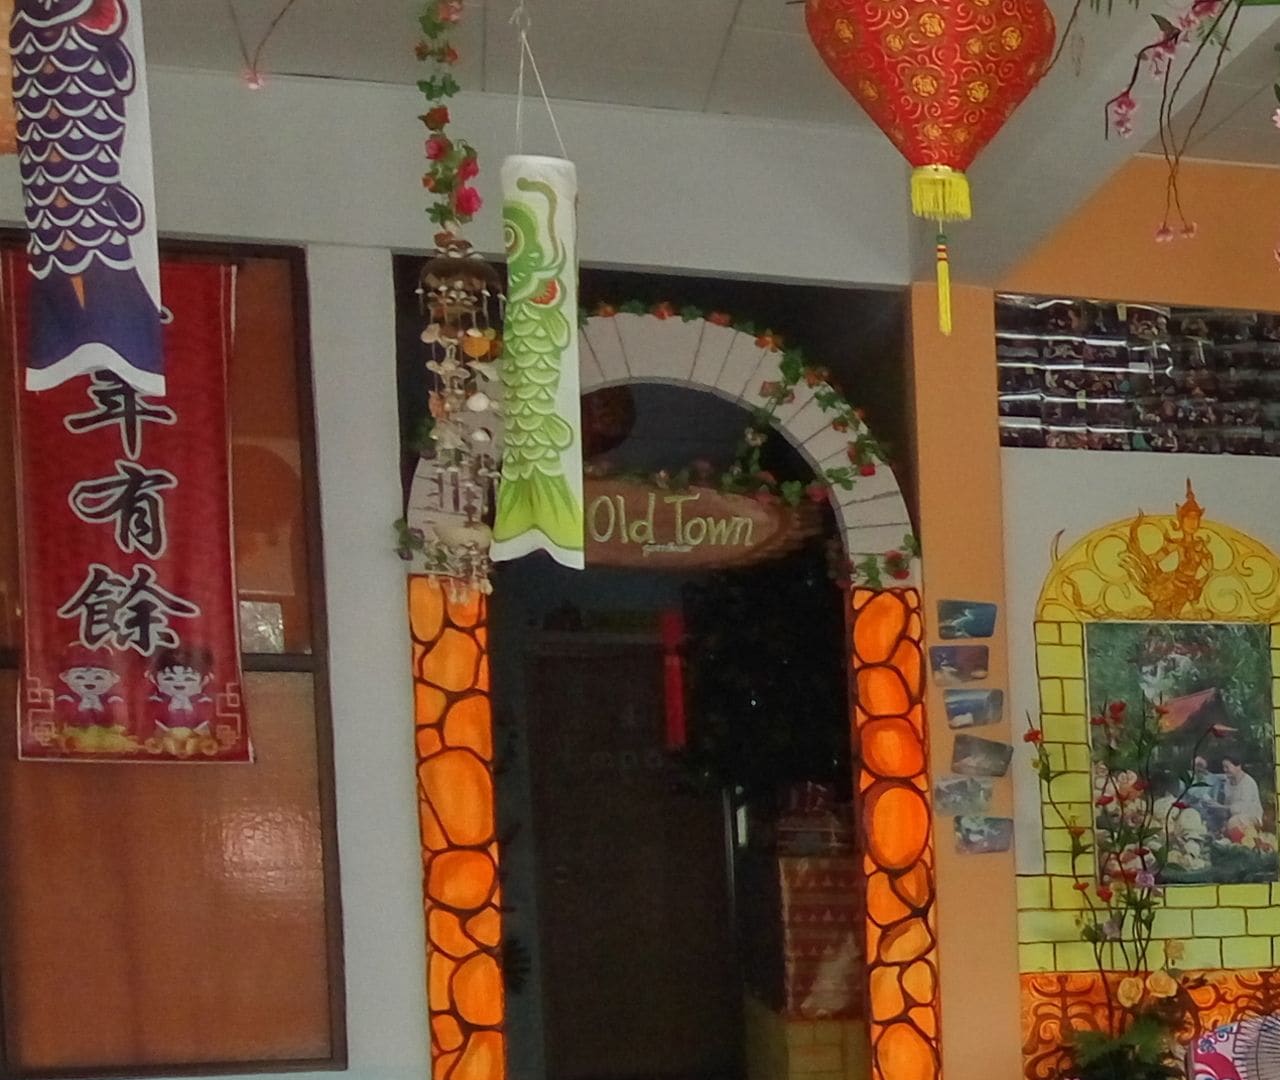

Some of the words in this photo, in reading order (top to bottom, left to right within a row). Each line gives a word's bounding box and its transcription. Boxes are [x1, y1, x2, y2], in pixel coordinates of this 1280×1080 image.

[58, 304, 200, 657] 年有餘
[591, 492, 656, 544] Old
[664, 492, 753, 546] Town
